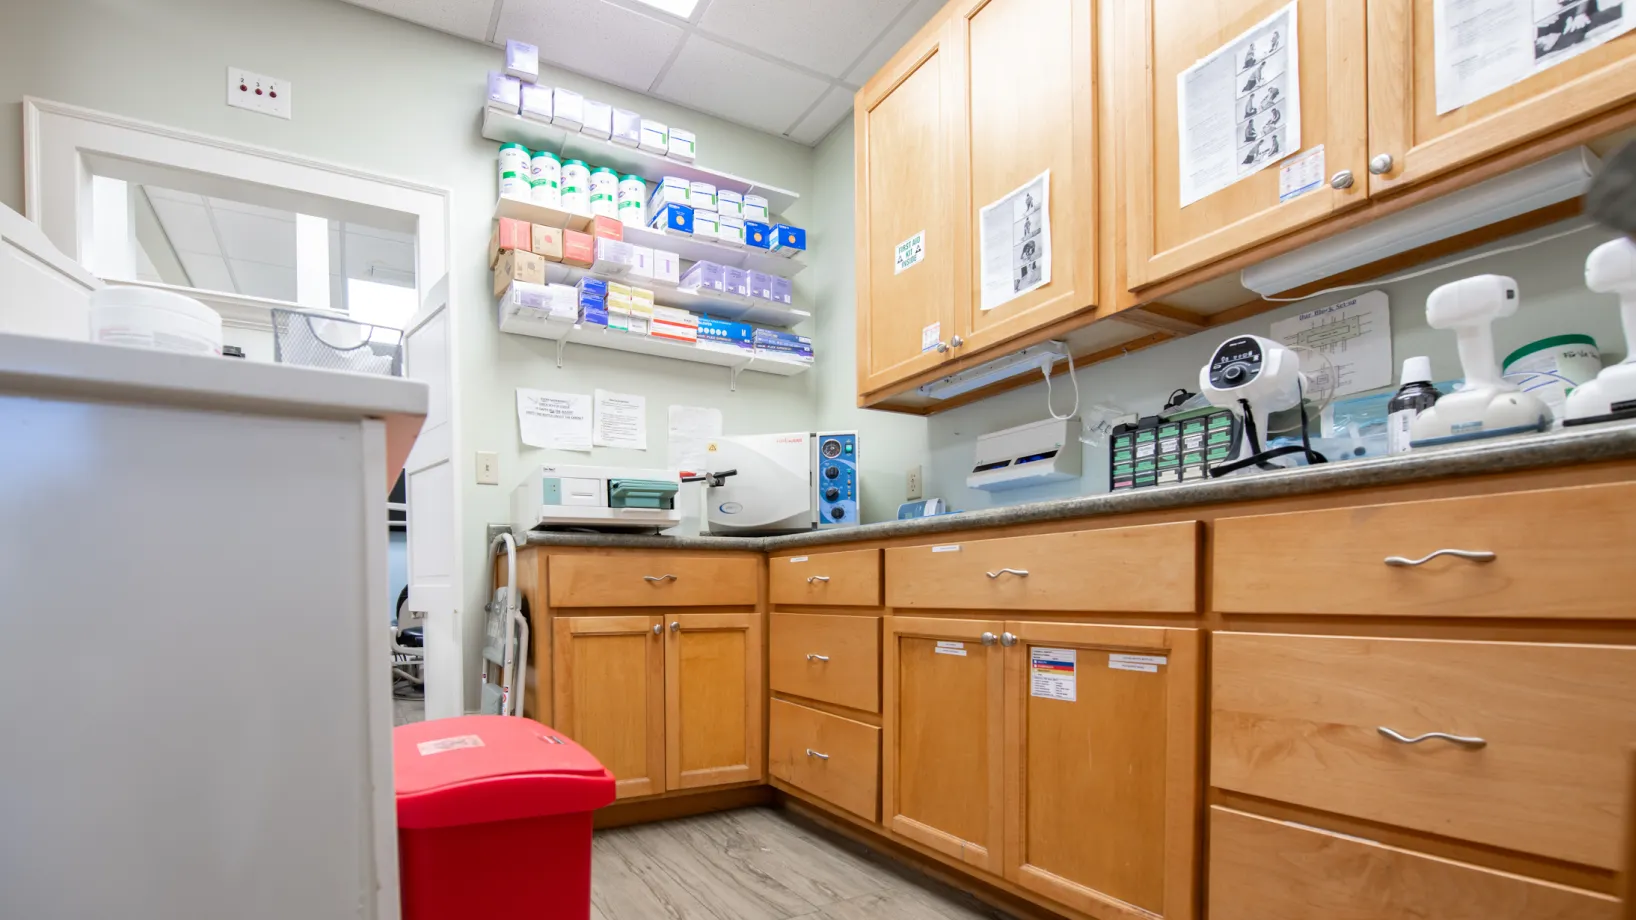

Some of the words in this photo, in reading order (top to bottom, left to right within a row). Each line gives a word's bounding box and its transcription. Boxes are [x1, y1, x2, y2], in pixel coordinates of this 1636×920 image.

[899, 241, 911, 254] FIRST
[912, 236, 920, 246] AID
[902, 254, 916, 268] INSIDE
